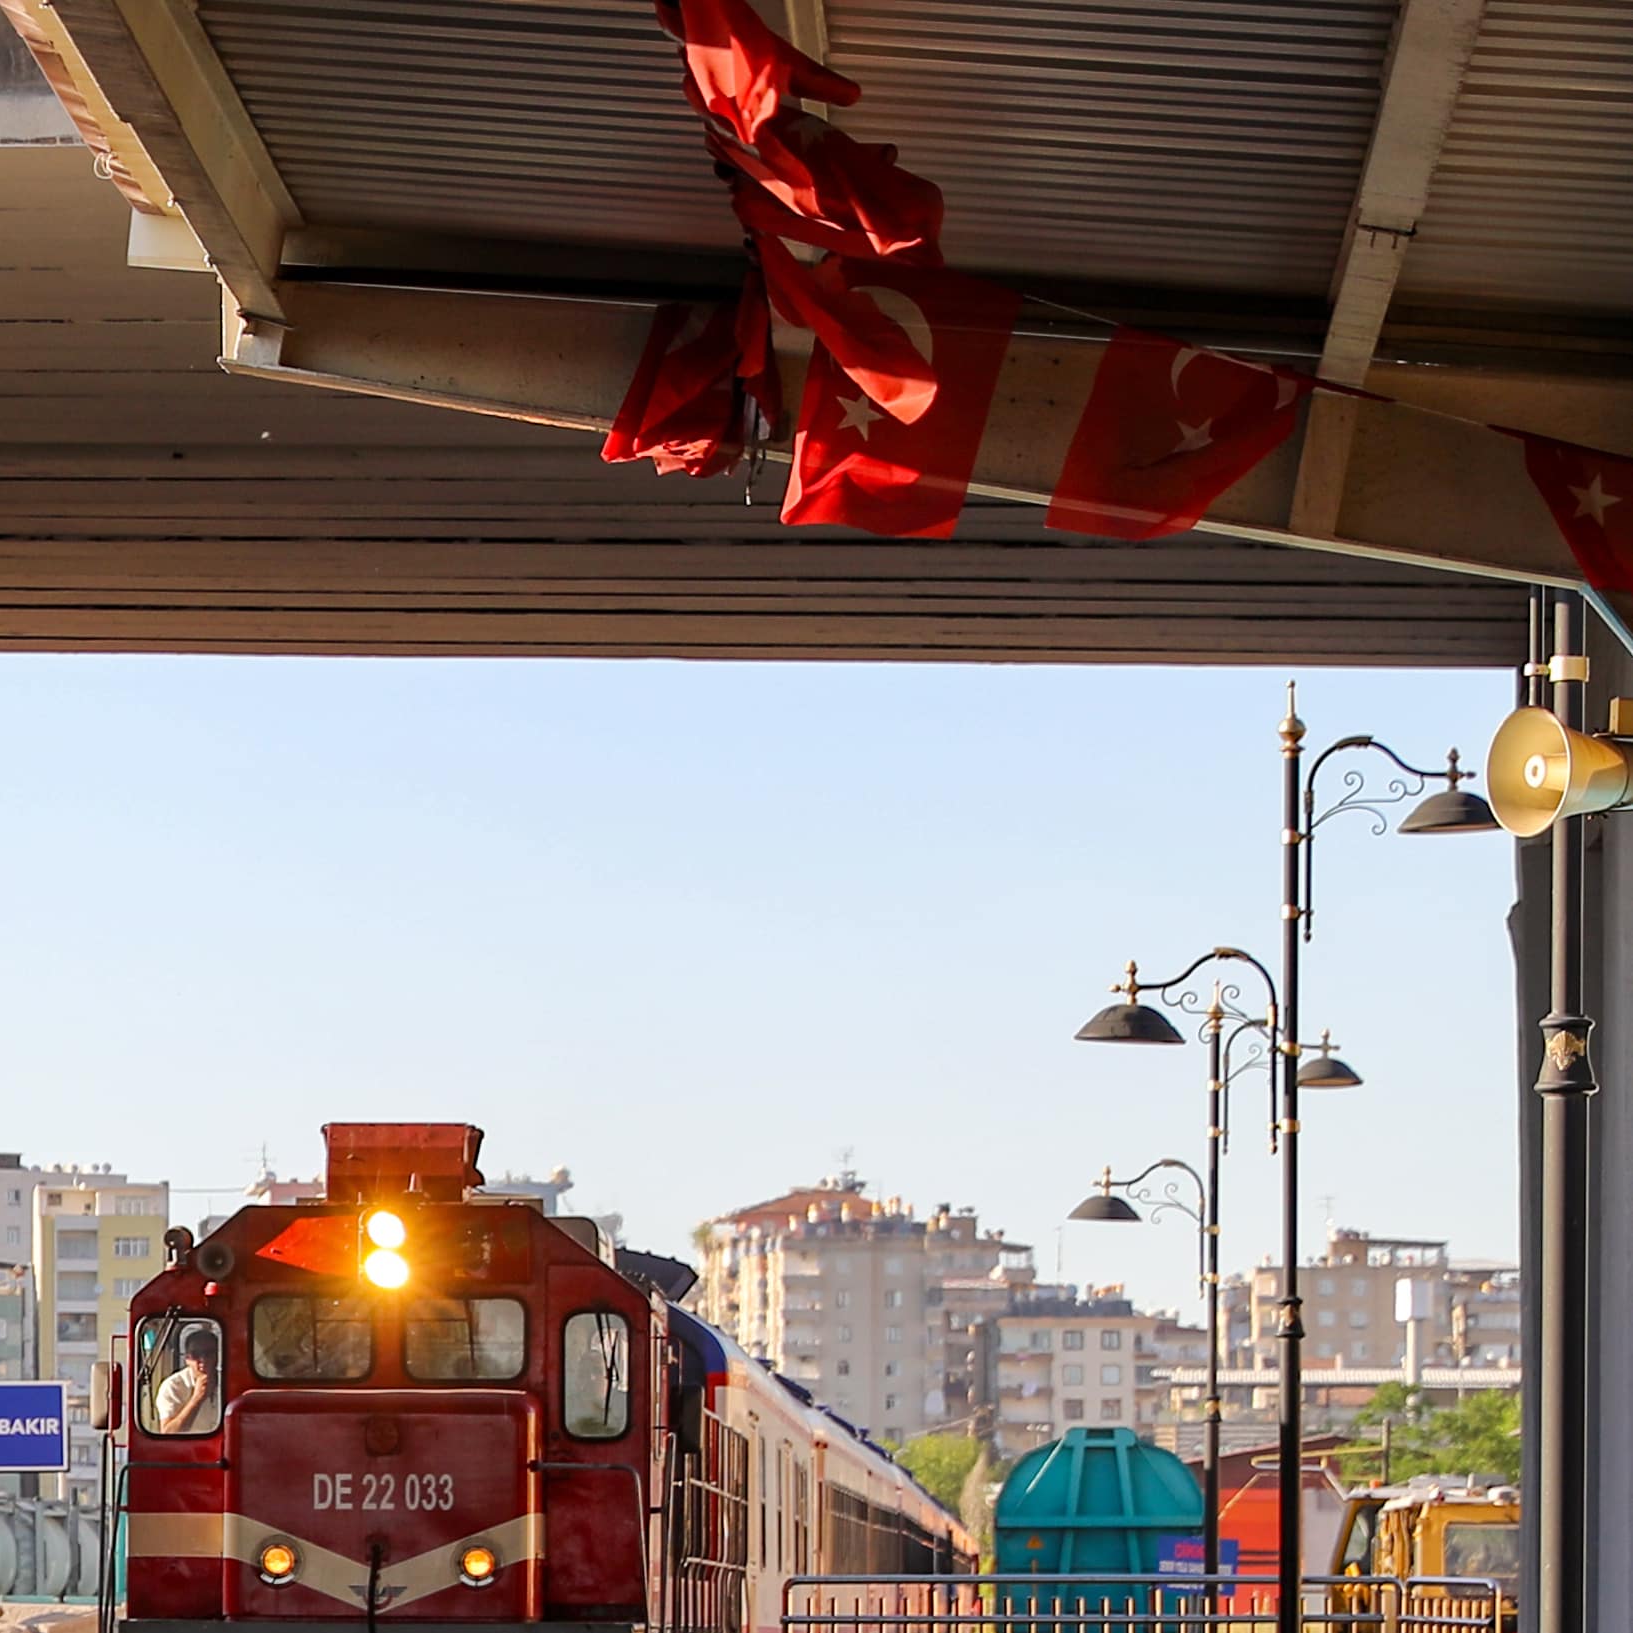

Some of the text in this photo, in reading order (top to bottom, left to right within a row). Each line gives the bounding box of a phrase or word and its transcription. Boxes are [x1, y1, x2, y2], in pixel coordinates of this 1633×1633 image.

[312, 1473, 455, 1511] DE 22 033
